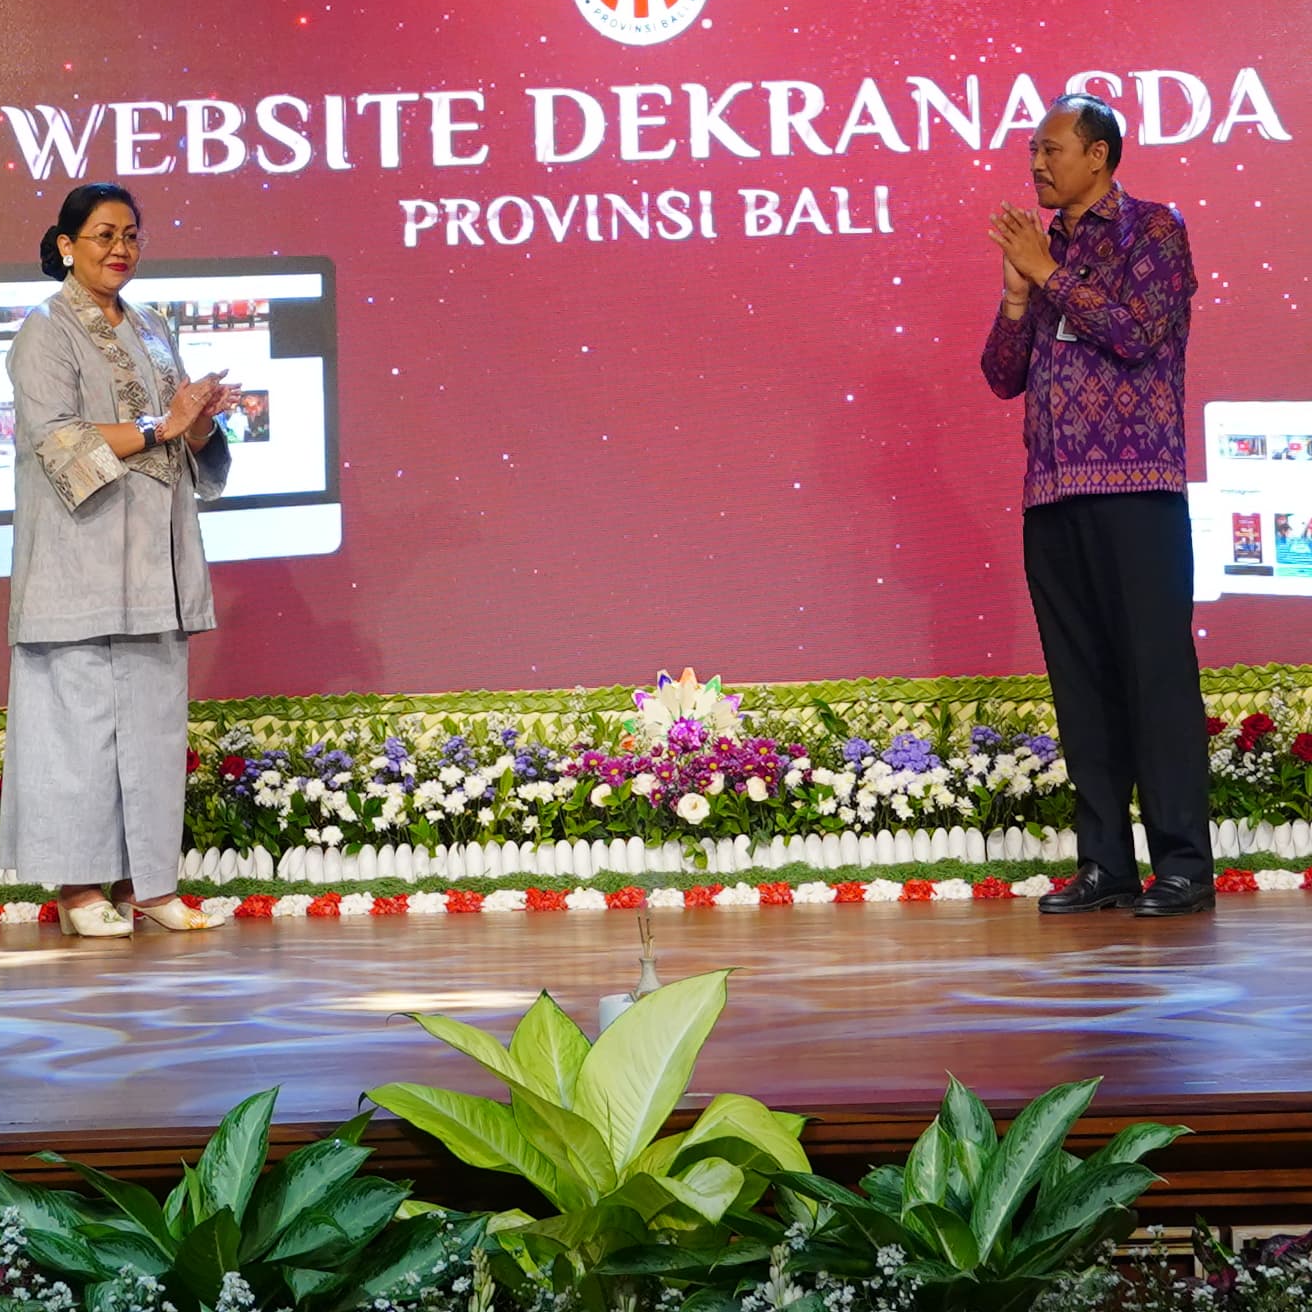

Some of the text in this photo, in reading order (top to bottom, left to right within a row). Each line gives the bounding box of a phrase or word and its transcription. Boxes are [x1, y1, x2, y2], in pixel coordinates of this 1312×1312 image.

[0, 89, 489, 180] WEBSITE
[399, 185, 894, 248] PROVINSI BALI
